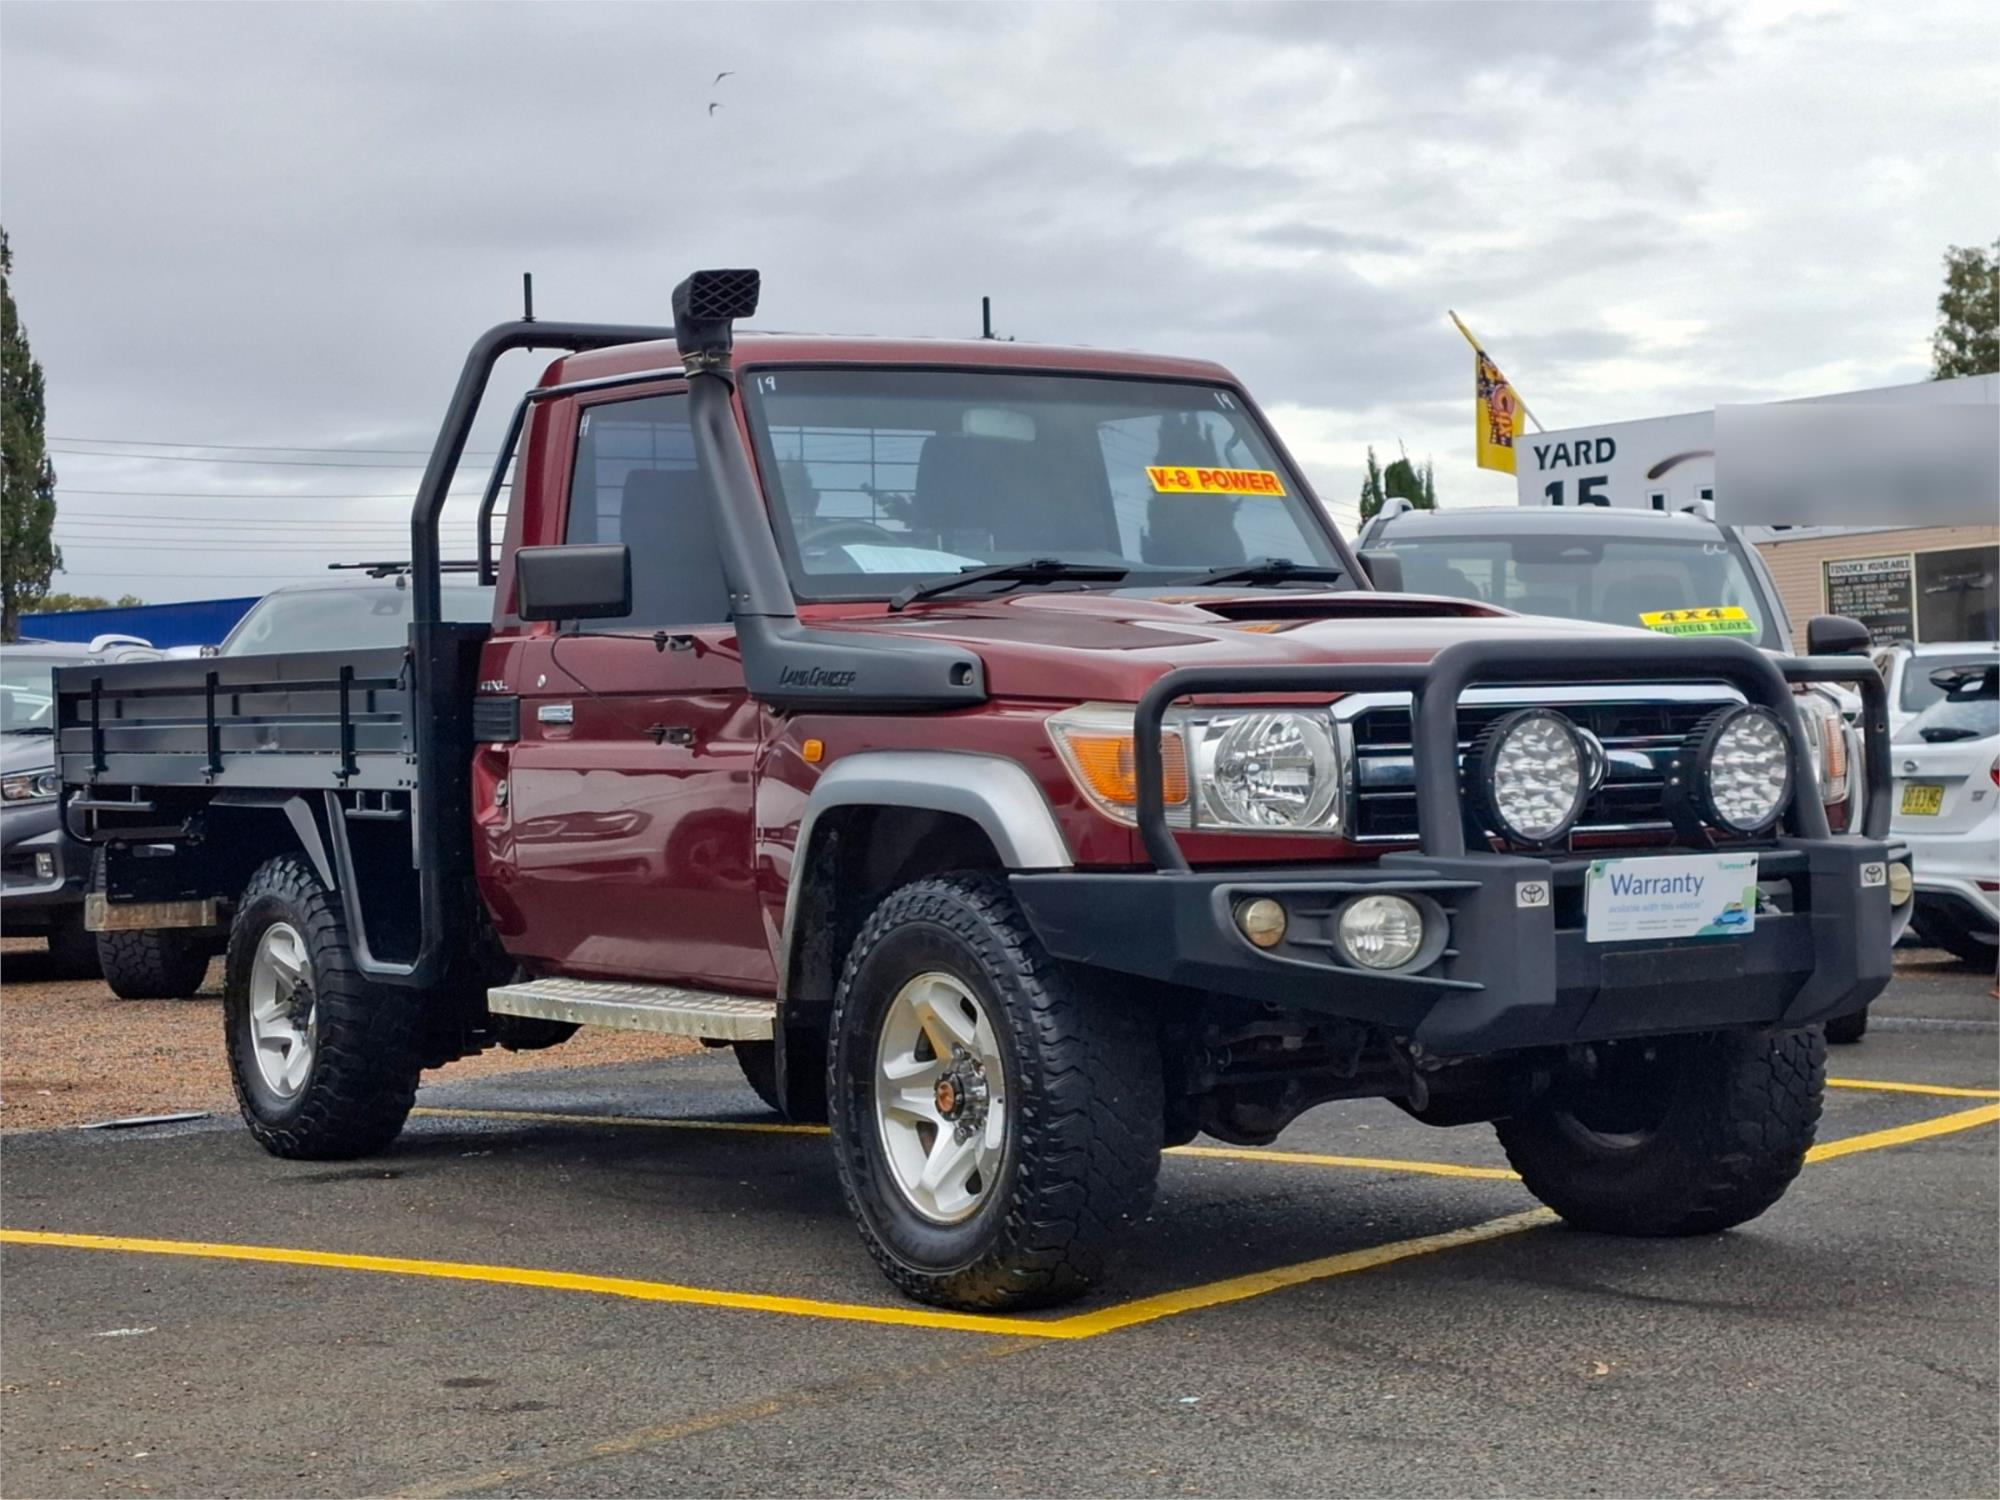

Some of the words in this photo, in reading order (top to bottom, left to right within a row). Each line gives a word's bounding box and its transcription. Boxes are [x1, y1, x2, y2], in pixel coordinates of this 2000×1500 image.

[757, 376, 776, 394] 19
[1533, 437, 1616, 470] YARD
[1150, 468, 1192, 488] V-8
[1196, 470, 1279, 491] POWER
[1545, 475, 1611, 507] 15
[1711, 621, 1753, 631] SEATS
[1610, 874, 1704, 896] Warranty
